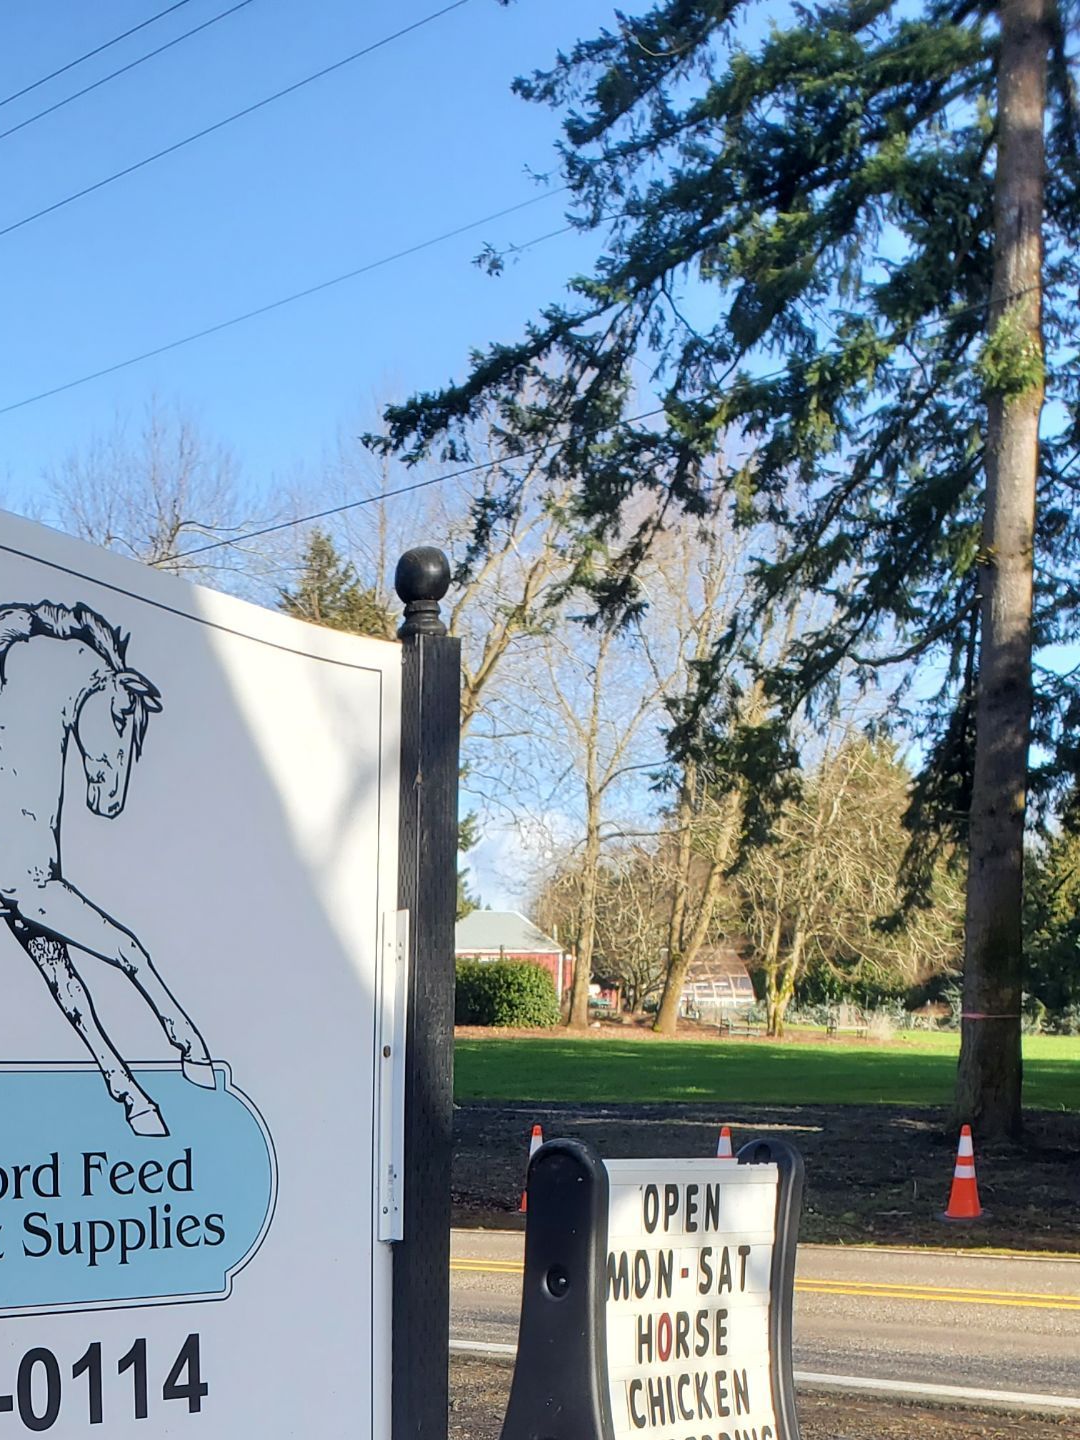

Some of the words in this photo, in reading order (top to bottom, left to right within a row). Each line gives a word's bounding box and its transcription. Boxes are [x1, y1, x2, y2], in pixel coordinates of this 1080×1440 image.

[80, 1148, 195, 1196] Feed
[22, 1205, 226, 1267] Supplies
[643, 1183, 721, 1234] OPEN
[637, 1308, 729, 1364] HORSE
[629, 1368, 750, 1429] CHICKEN
